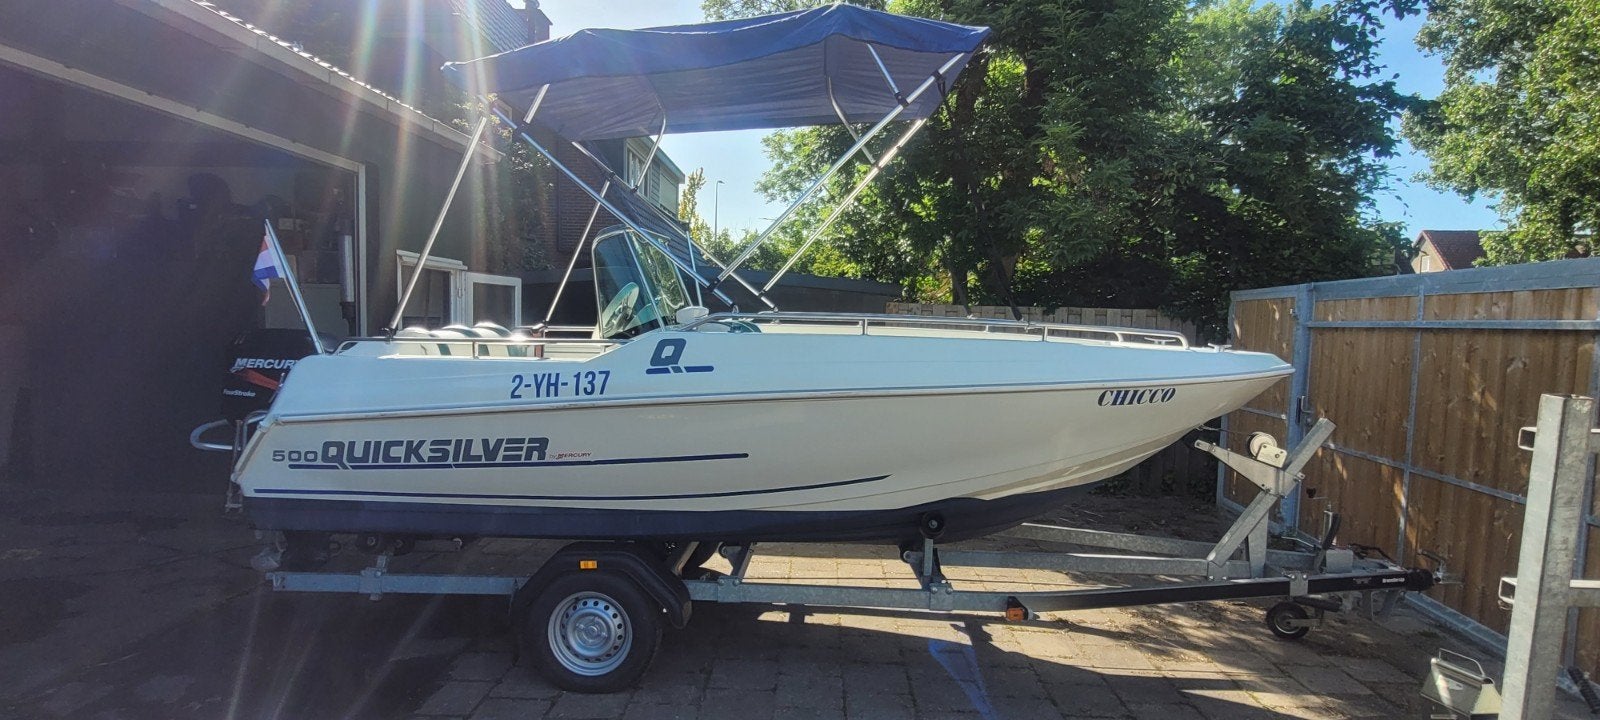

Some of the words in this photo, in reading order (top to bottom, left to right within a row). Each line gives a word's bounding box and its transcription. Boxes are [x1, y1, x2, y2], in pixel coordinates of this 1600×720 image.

[510, 370, 611, 399] 2-YH-137
[1097, 387, 1176, 407] CHICCO
[272, 450, 318, 462] 500
[321, 437, 550, 469] QUICKSILVER
